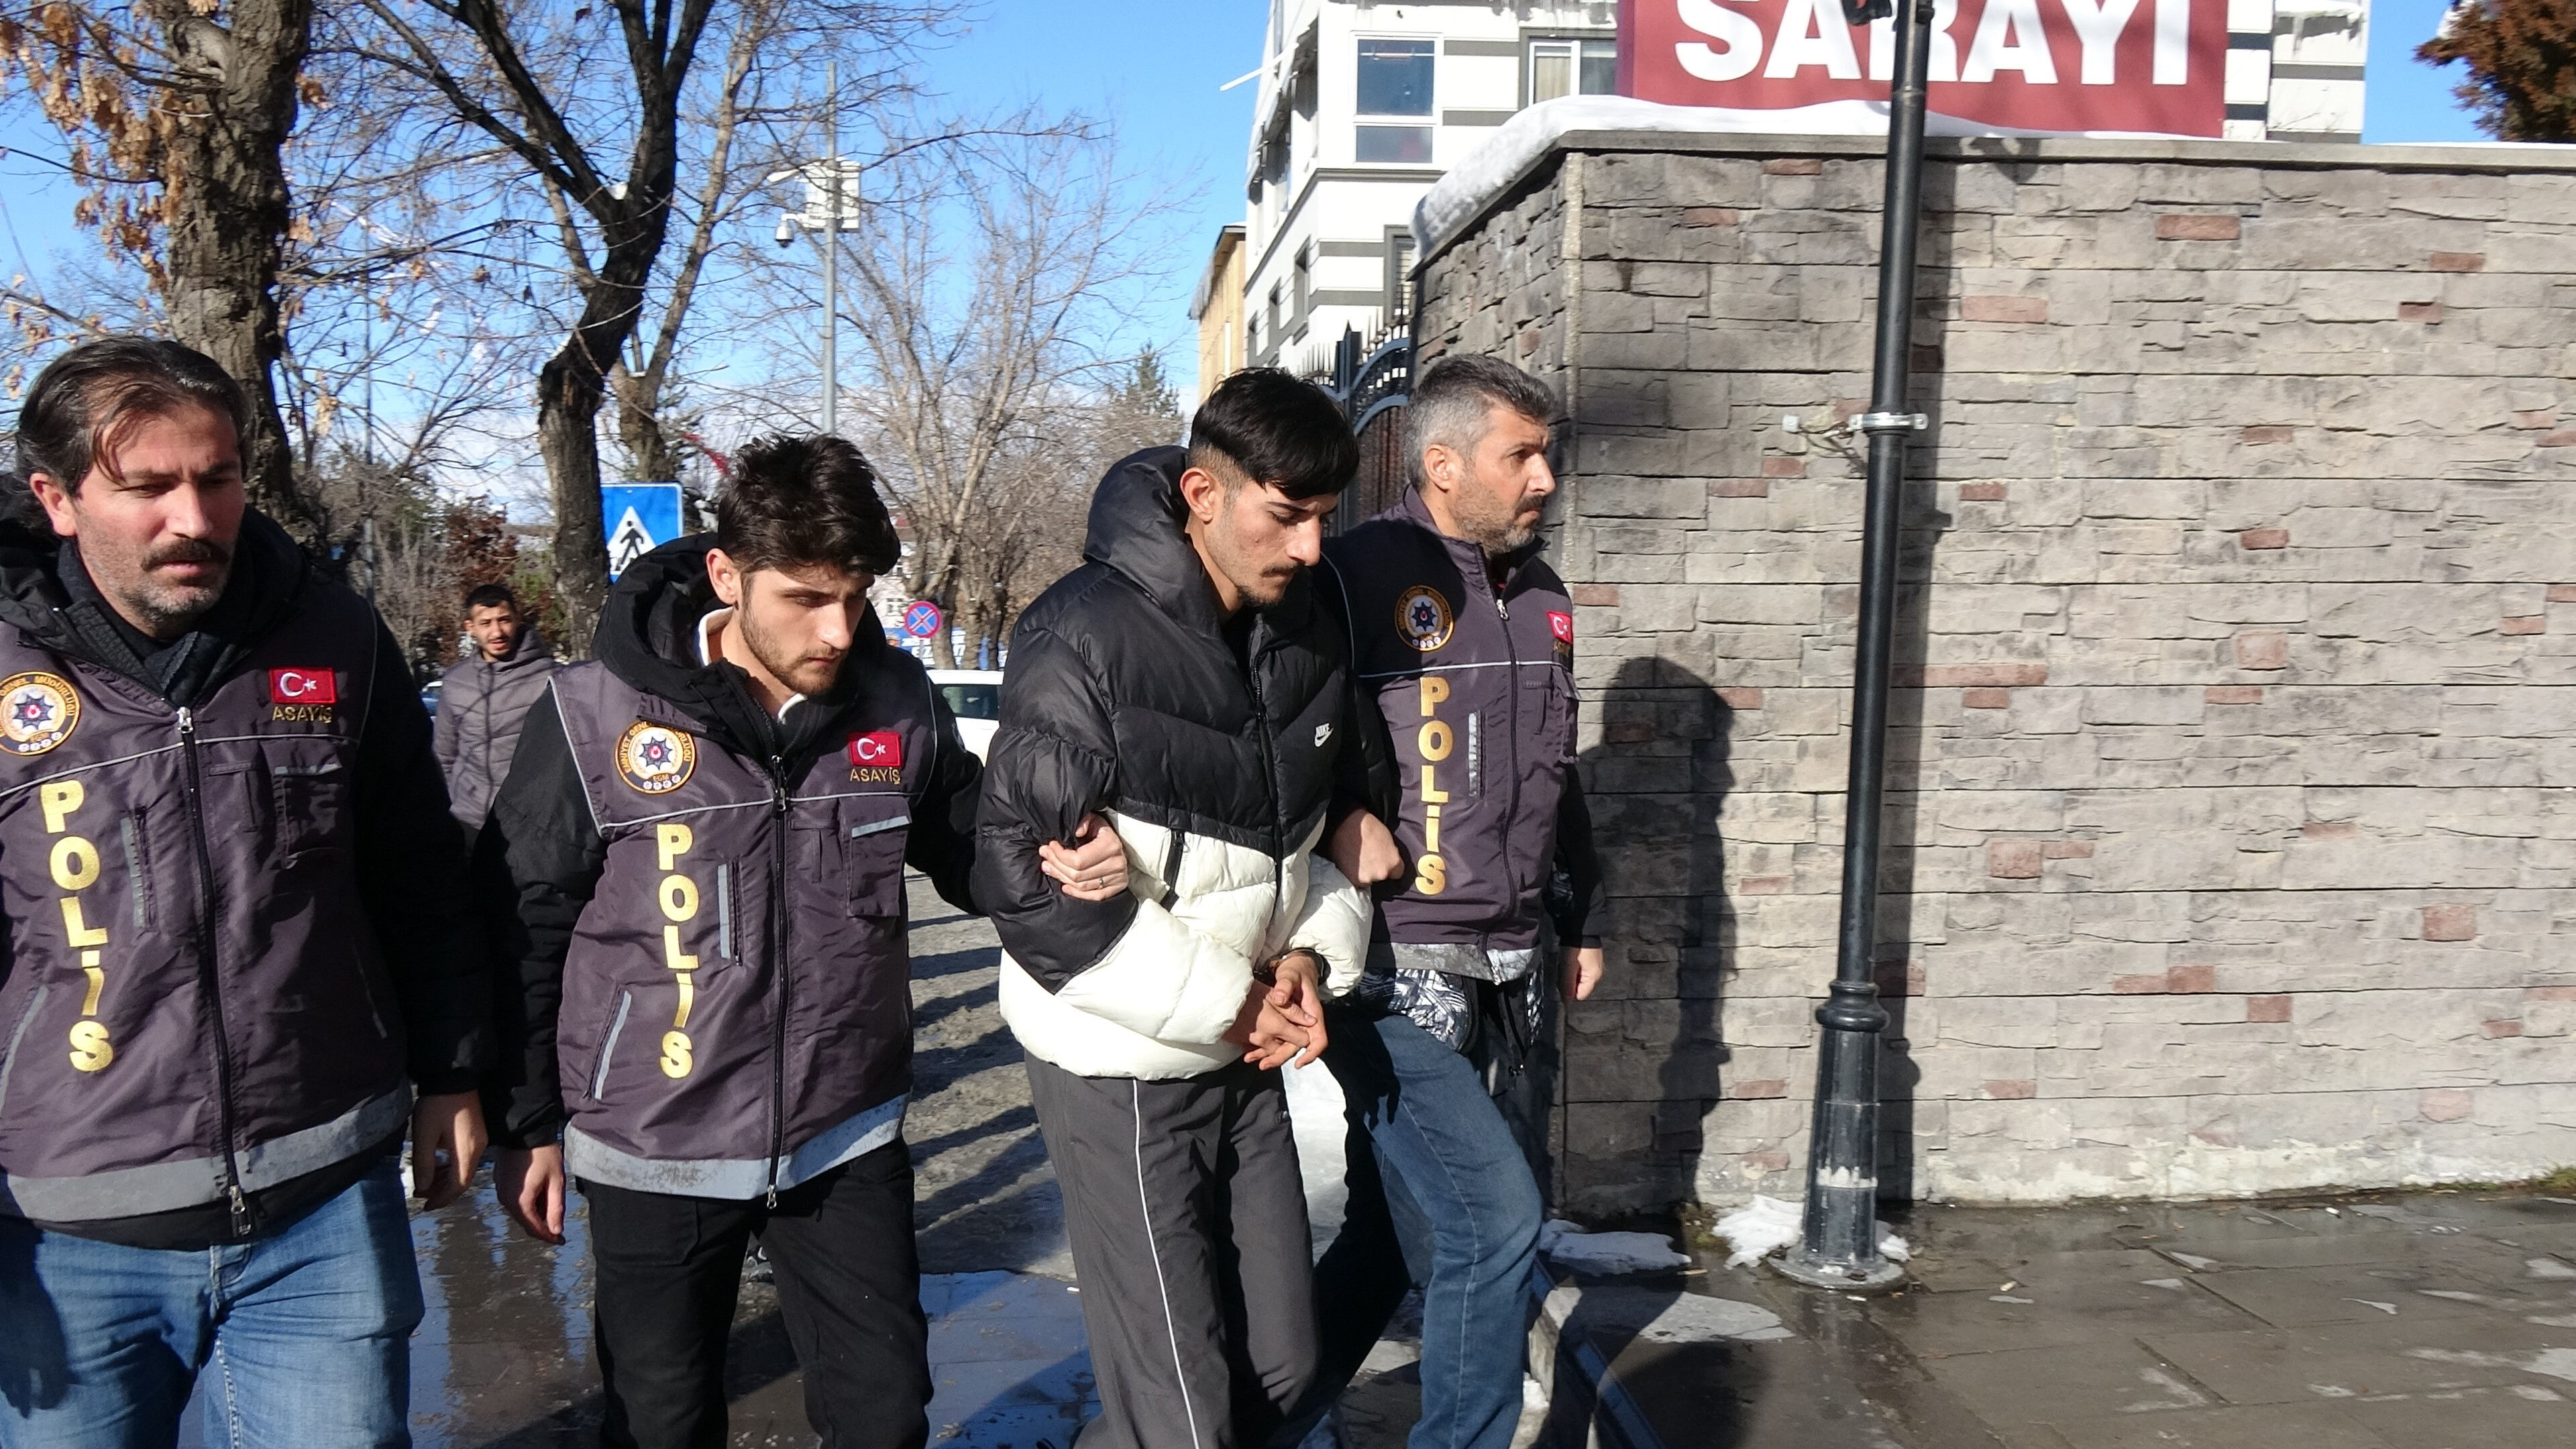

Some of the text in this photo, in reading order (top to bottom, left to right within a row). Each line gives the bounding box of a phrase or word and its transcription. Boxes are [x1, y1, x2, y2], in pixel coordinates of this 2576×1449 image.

[1675, 0, 2188, 85] SARAYI
[272, 704, 332, 724] ASAYİŞ
[1316, 722, 1330, 737] NIKE
[849, 766, 901, 786] ASAYİŞ
[1415, 676, 1454, 896] POLİS
[40, 779, 114, 1072] POLİS
[656, 822, 700, 1079] POLİS
